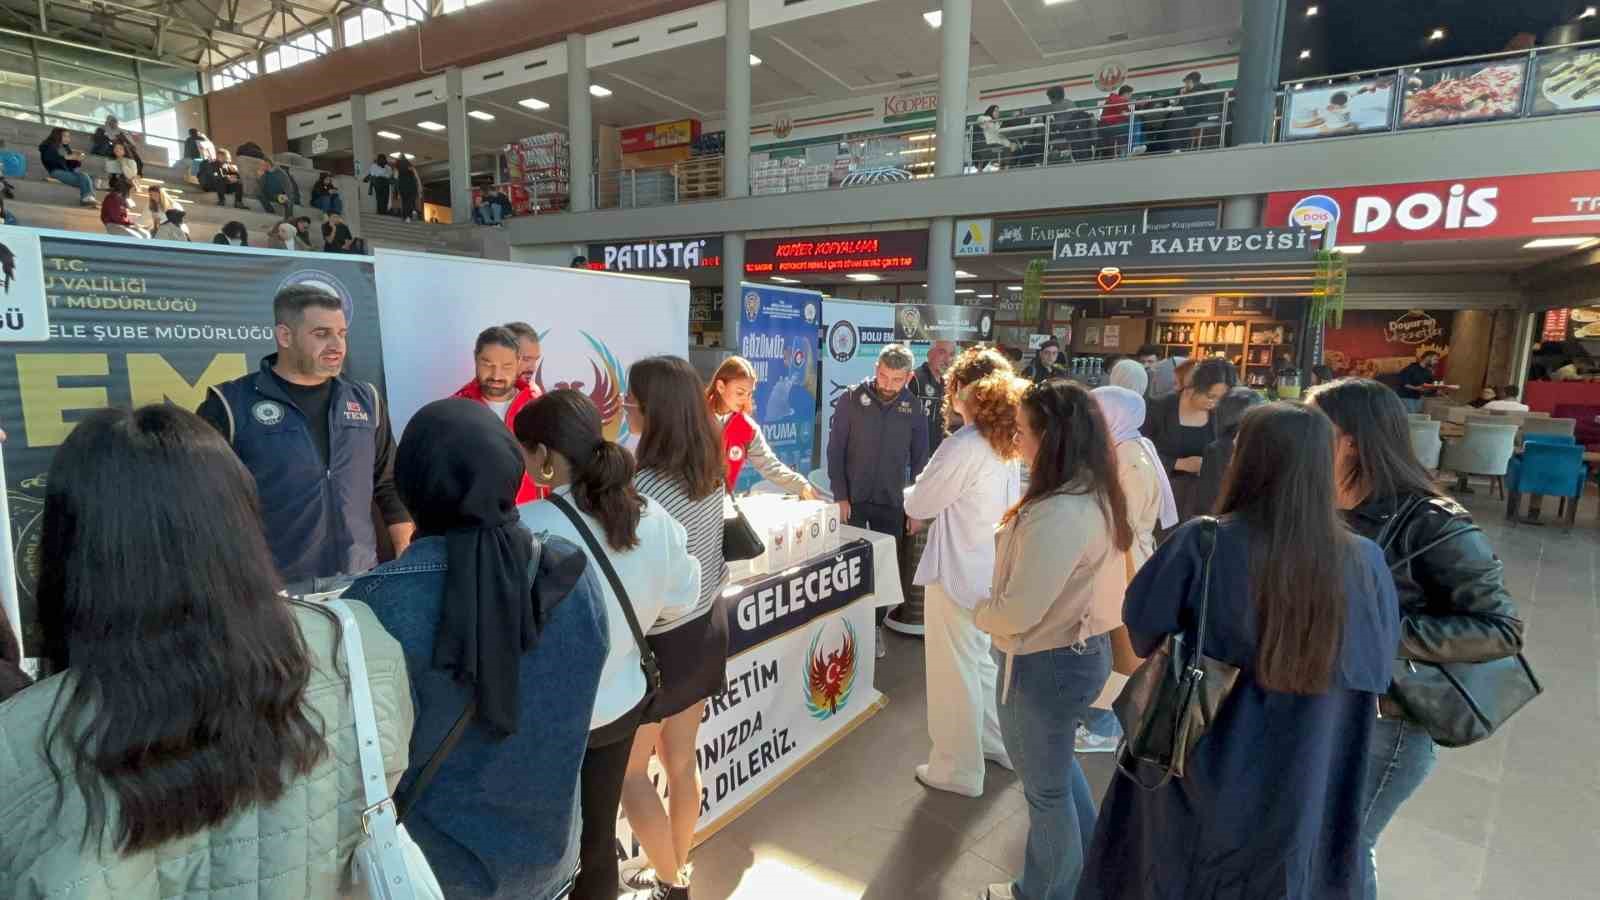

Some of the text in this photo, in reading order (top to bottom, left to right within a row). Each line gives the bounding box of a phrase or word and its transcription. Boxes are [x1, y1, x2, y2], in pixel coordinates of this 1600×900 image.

[1059, 229, 1307, 258] ABANT KAHVECİSİ
[52, 258, 89, 273] T.C.
[604, 241, 700, 271] PATISTA
[61, 275, 147, 294] VALİLİĞİ
[67, 294, 198, 312] MÜDÜRLÜĞÜ
[93, 325, 150, 342] ŞUBE
[155, 325, 274, 341] MÜDÜRLÜĞÜ
[861, 331, 882, 342] BOLU
[737, 553, 862, 631] GELECEĞE
[715, 728, 797, 803] DİLERİZ.
